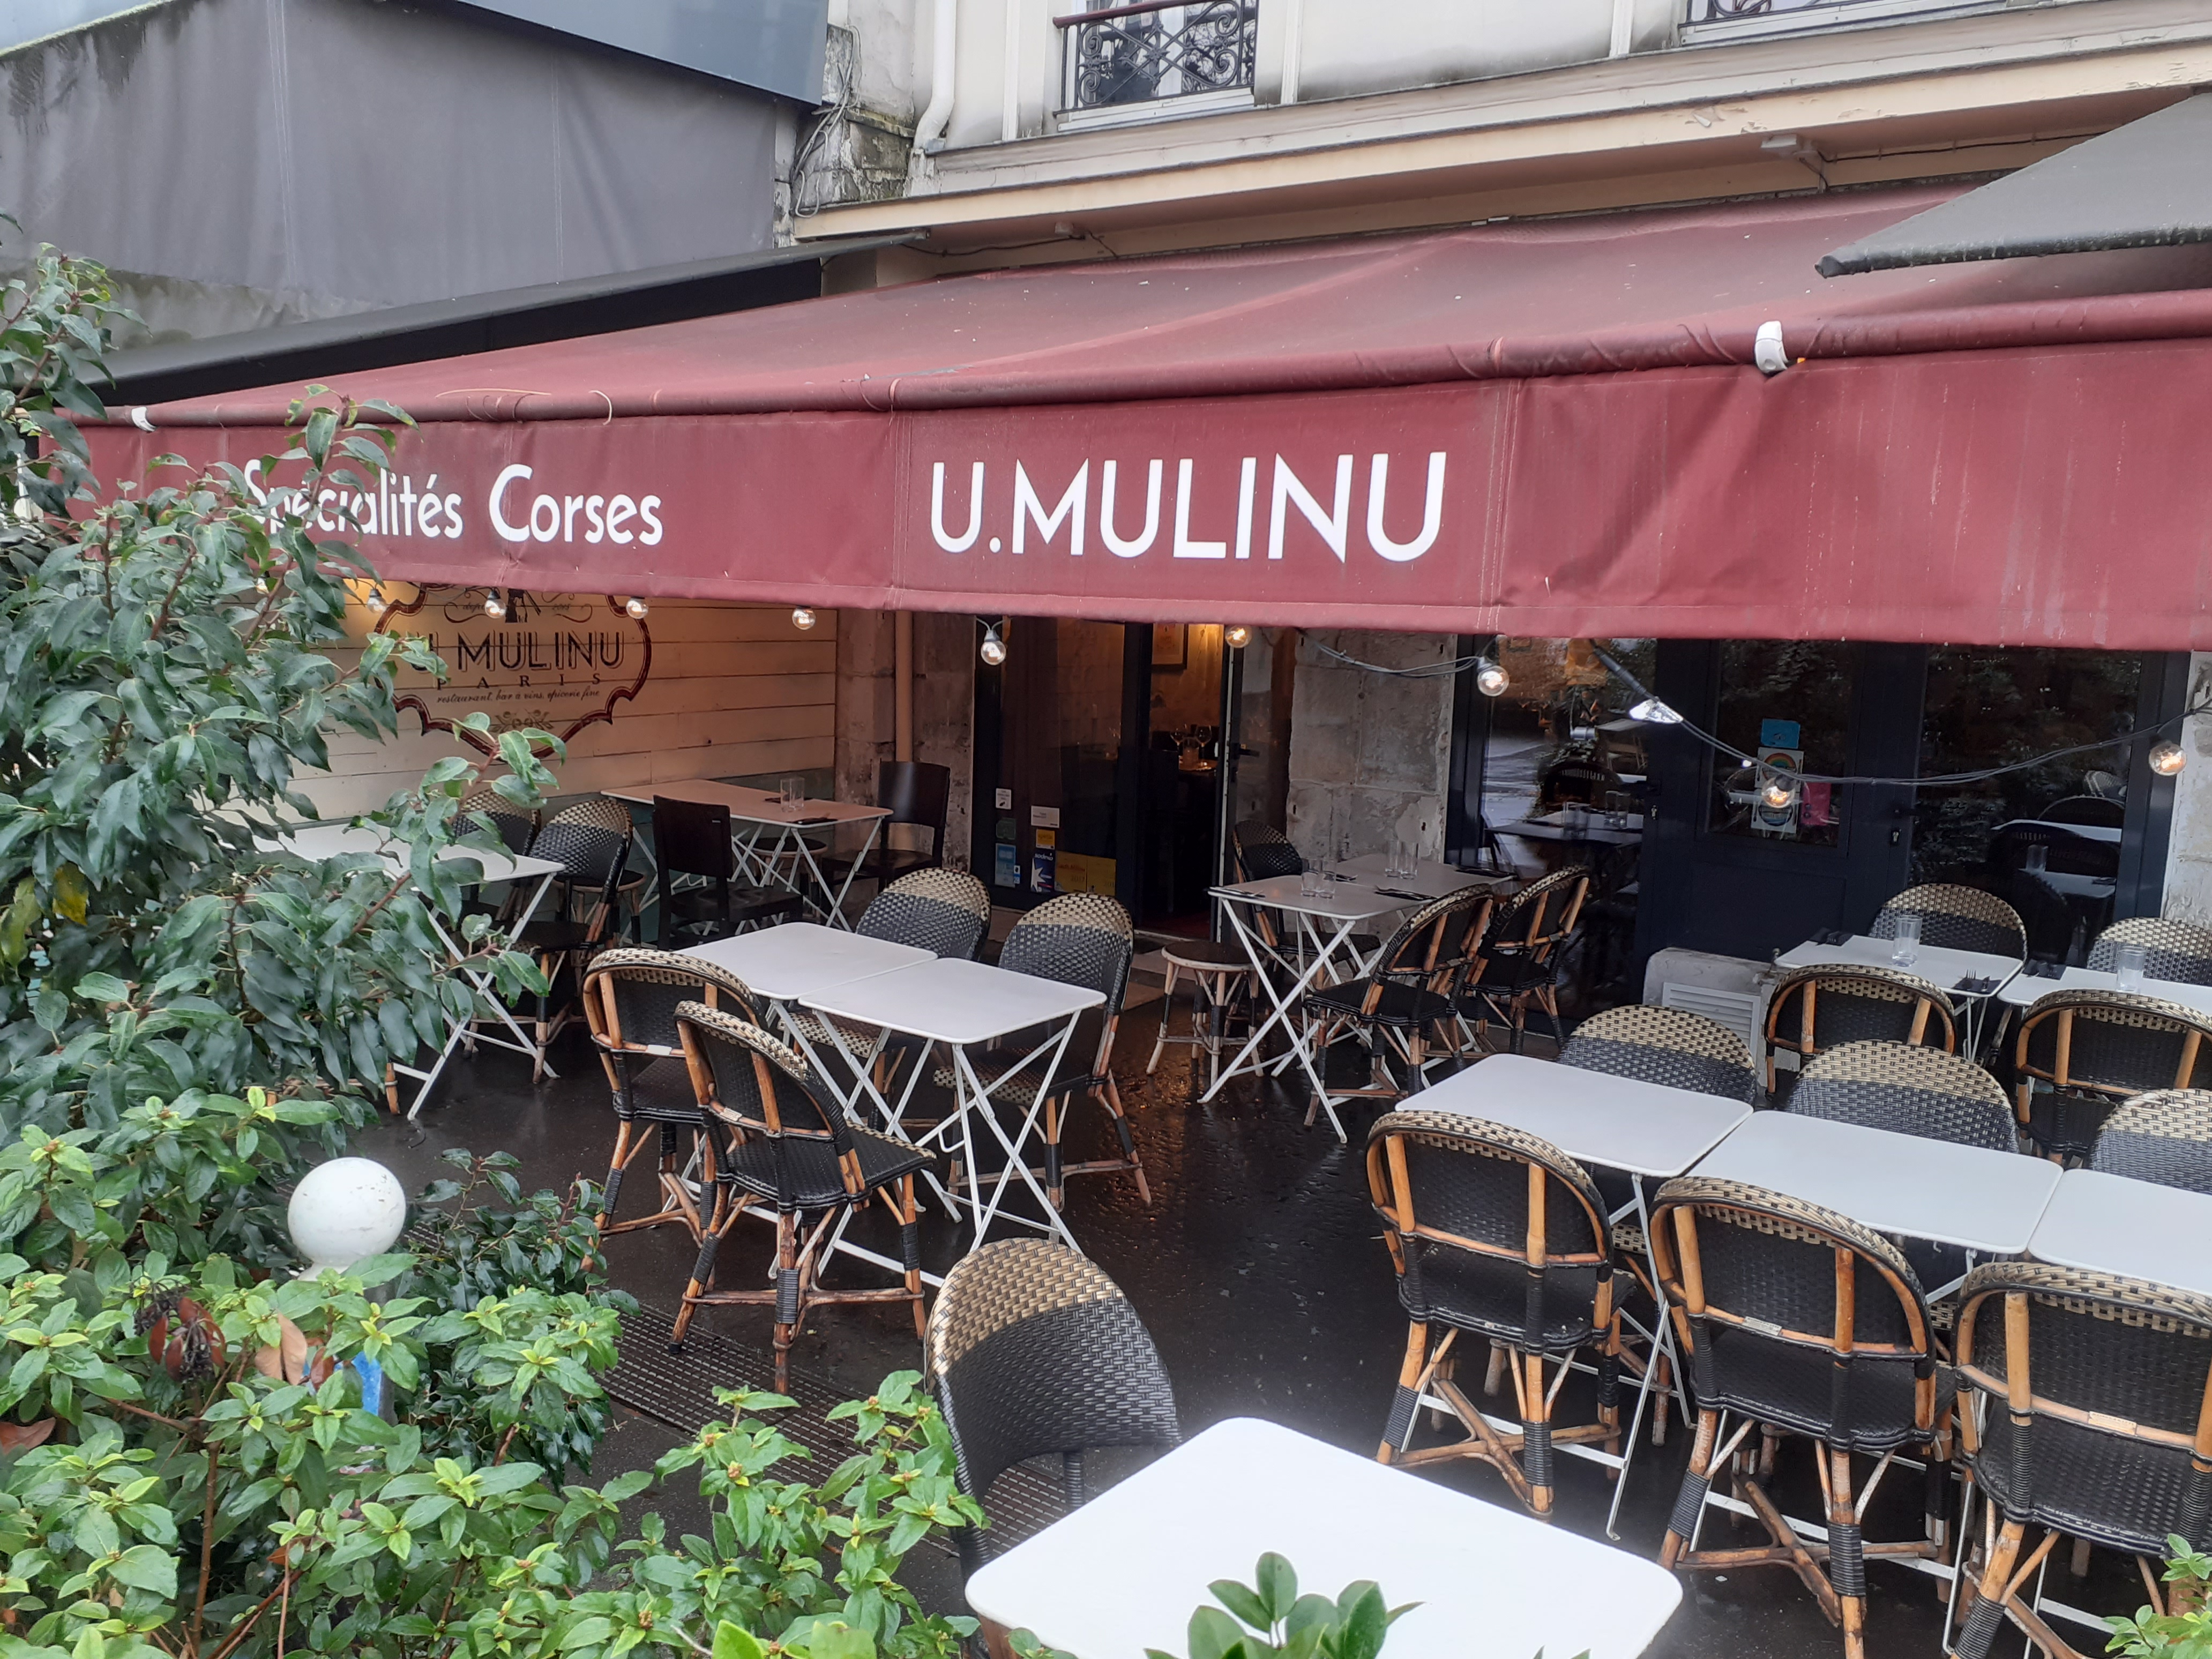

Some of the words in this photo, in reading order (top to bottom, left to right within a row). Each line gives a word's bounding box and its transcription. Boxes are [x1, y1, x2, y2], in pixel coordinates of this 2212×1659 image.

[244, 459, 464, 539] Spécialités
[489, 464, 663, 547] Corses
[931, 451, 1447, 563] U.MULINU
[457, 630, 624, 672] MULINU
[437, 673, 601, 691] PARIS
[496, 689, 512, 700] bar
[580, 685, 600, 701] fine
